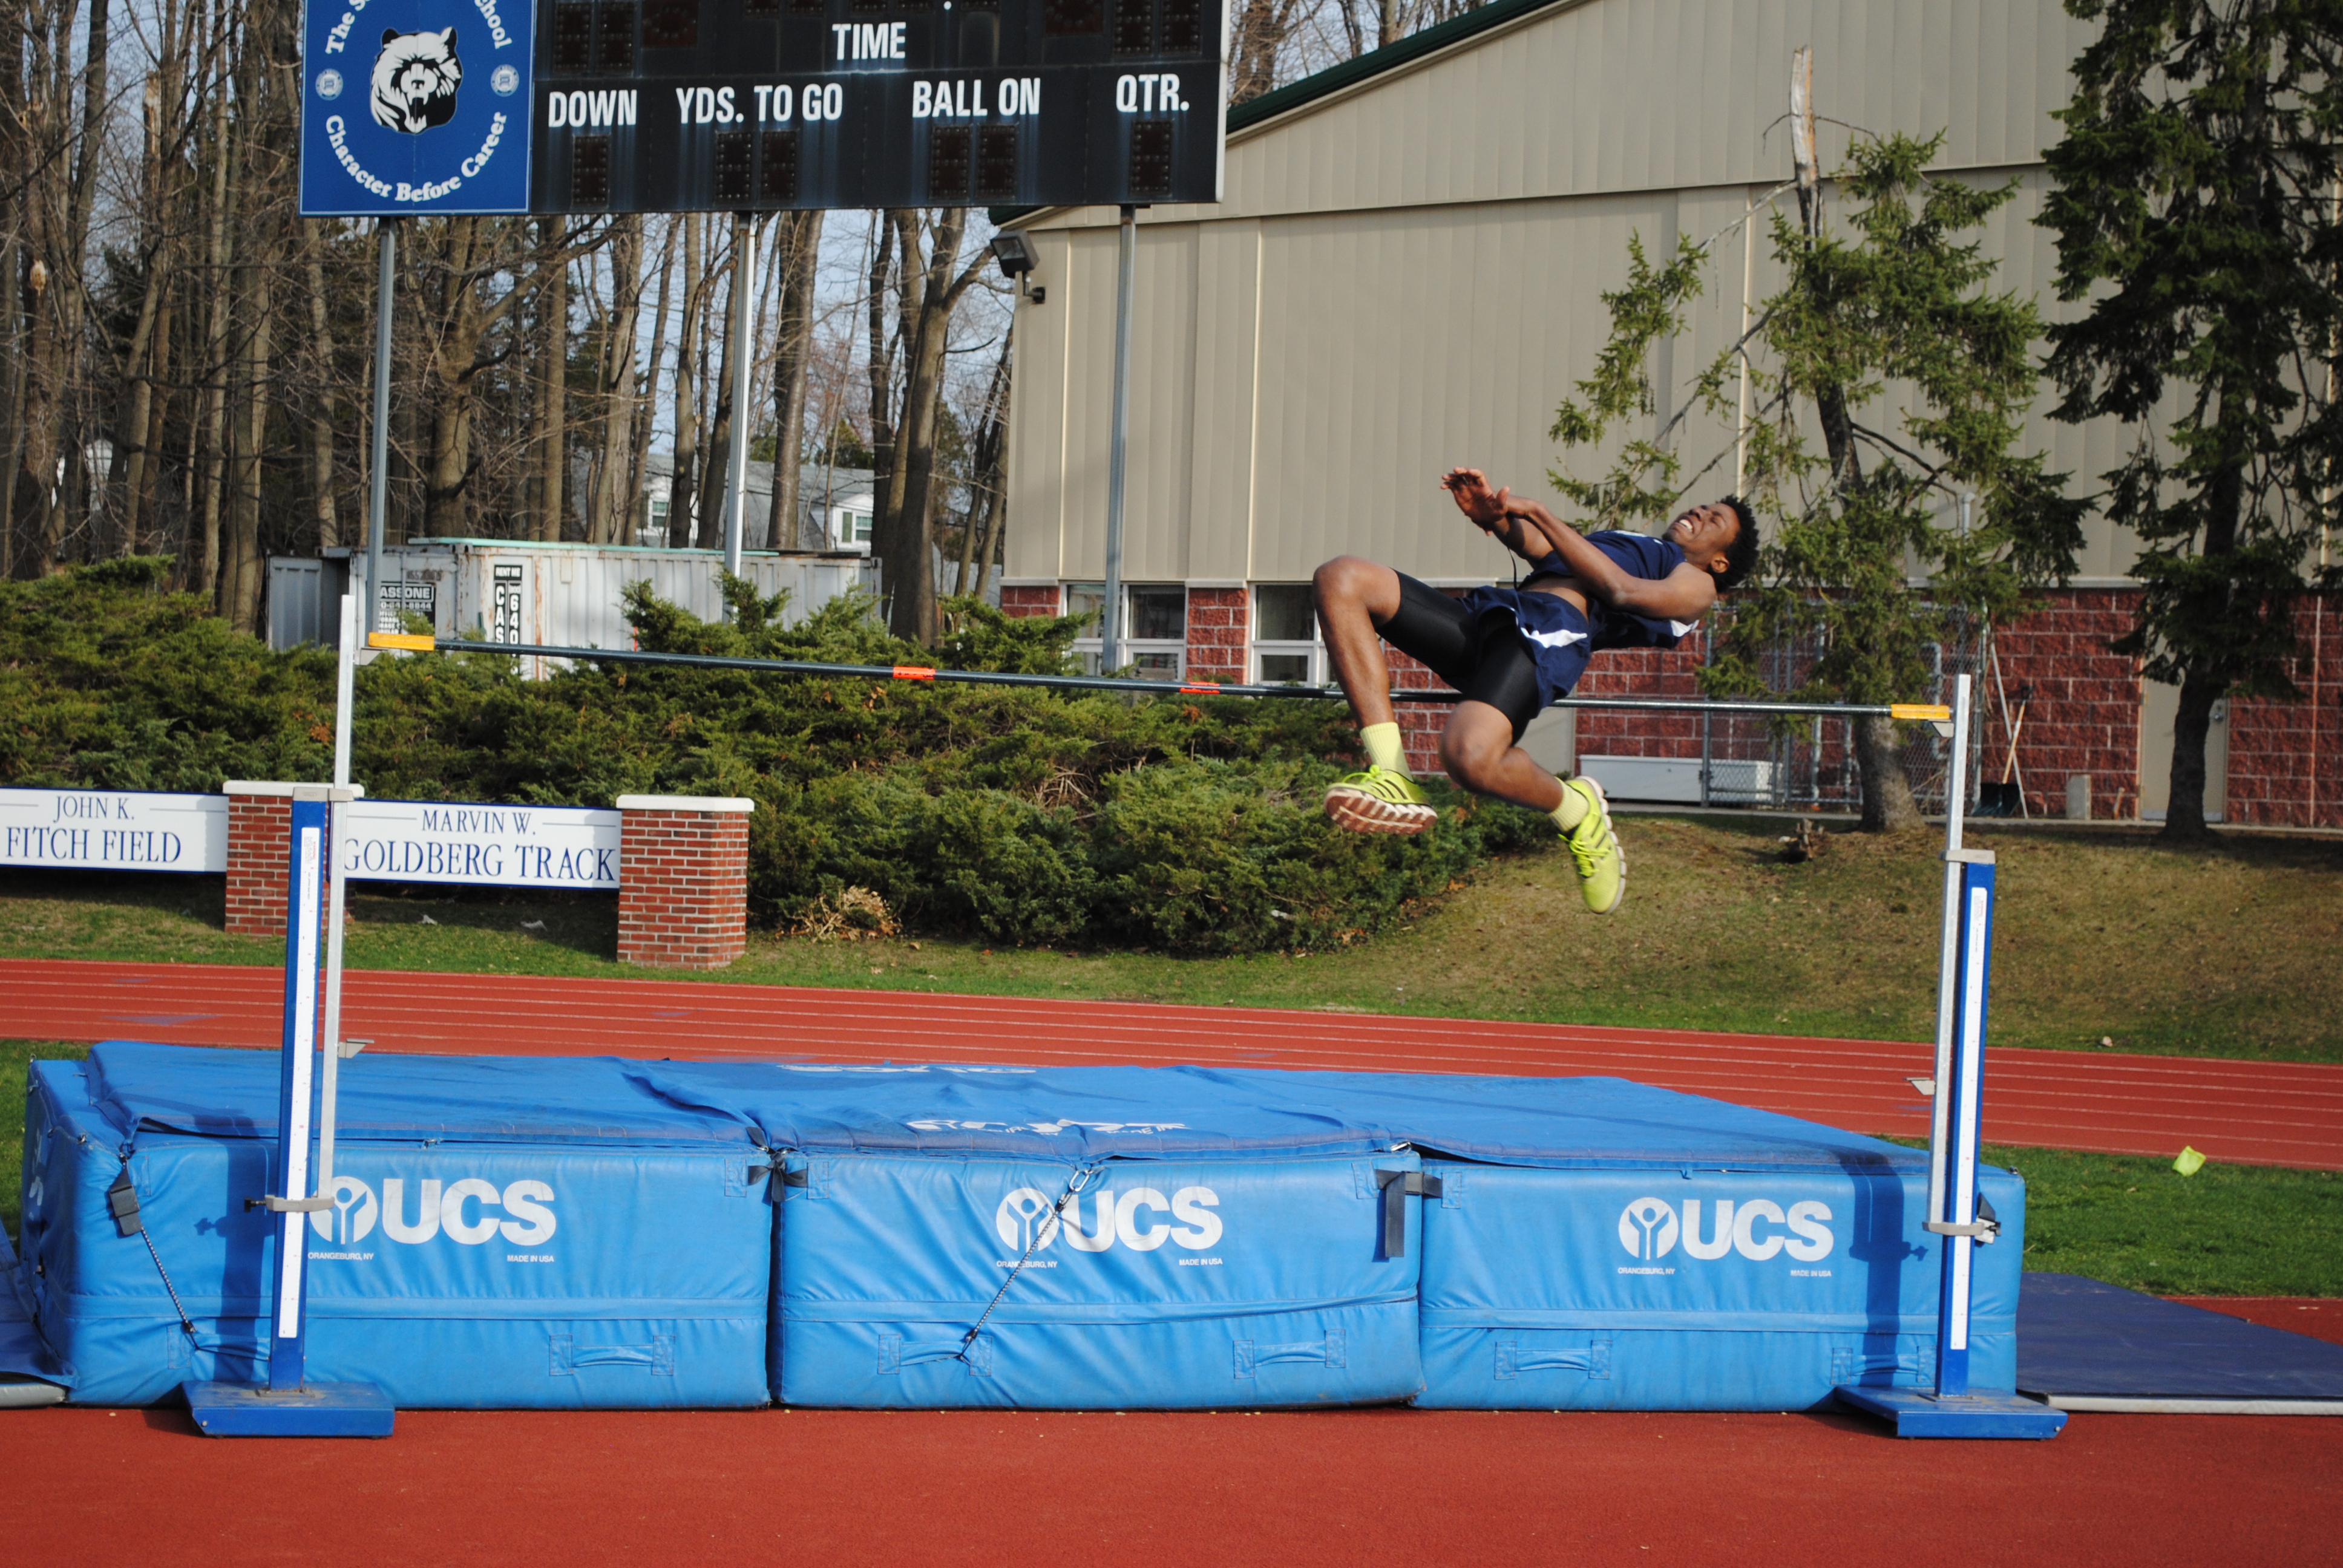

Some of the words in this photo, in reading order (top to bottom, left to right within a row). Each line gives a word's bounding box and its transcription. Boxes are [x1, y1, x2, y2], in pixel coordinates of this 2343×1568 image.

[326, 11, 355, 54] The
[474, 0, 513, 49] chool
[833, 22, 906, 60] TIME
[548, 89, 637, 127] DOWN
[676, 87, 744, 124] YDS.
[754, 84, 793, 122] TO
[802, 83, 843, 121] GO
[913, 79, 988, 118] BALL
[998, 77, 1041, 115] ON
[1116, 73, 1190, 113] QTR.
[326, 114, 392, 197] Character
[395, 176, 461, 202] Before
[461, 112, 506, 177] Career
[380, 586, 430, 599] ASSONE
[496, 585, 505, 644] CAS
[53, 796, 107, 823] JOHN
[117, 798, 134, 820] K.
[422, 809, 505, 834] MARVIN
[512, 812, 536, 835] W.
[5, 826, 88, 860] FITCH
[102, 830, 182, 863] FIELD
[344, 838, 503, 877] GOLDBERG
[515, 844, 616, 881] TRACK
[382, 1178, 556, 1246] UCS
[1061, 1186, 1223, 1252] UCS
[1682, 1199, 1833, 1261] UCS
[308, 1252, 362, 1261] ORANGEBURG,
